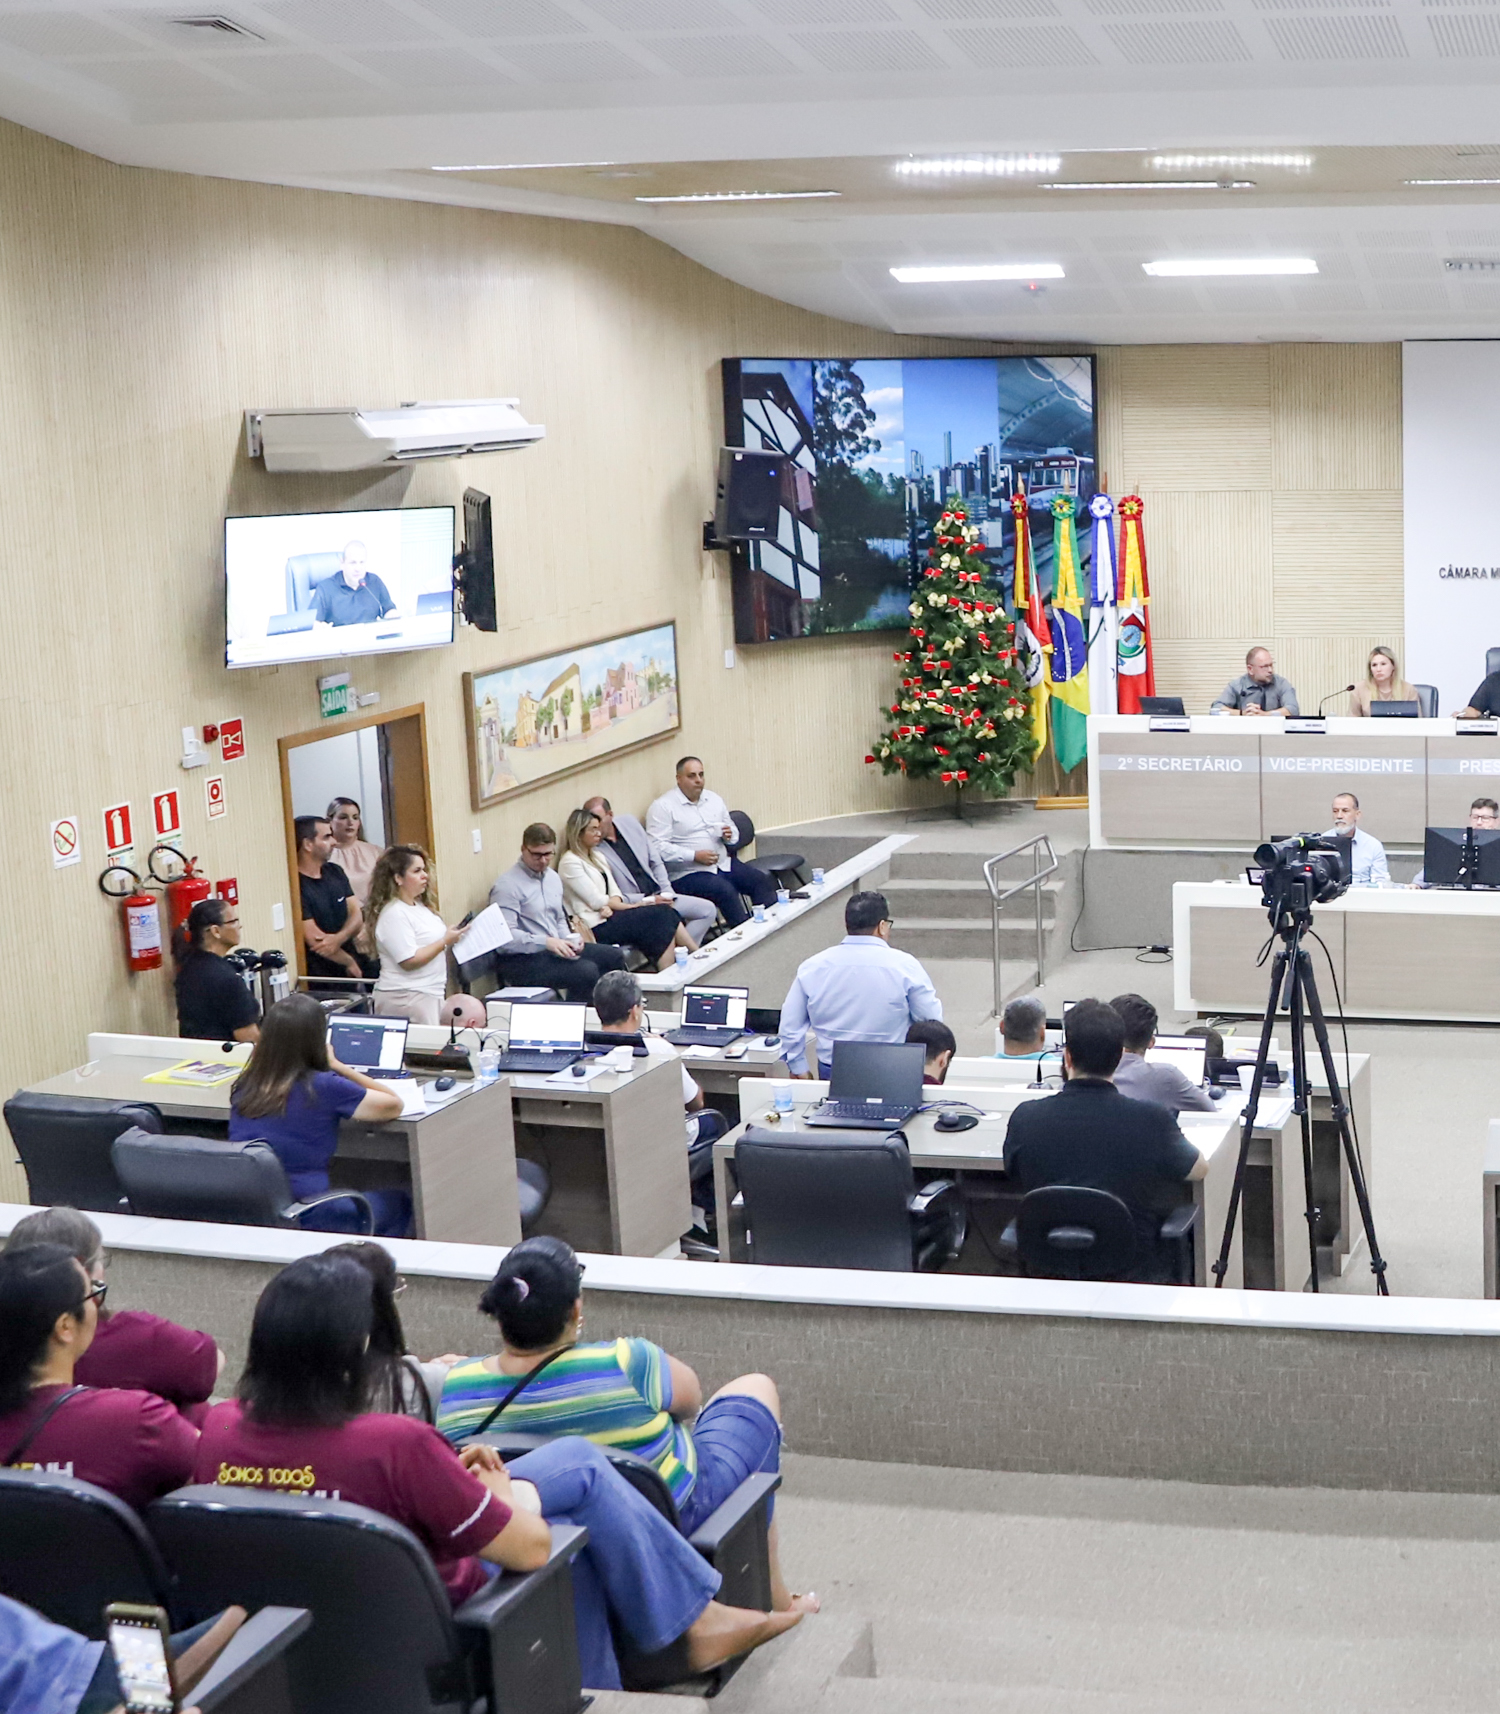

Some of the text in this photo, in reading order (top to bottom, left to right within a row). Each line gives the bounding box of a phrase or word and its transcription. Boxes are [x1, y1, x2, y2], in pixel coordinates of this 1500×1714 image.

[1439, 563, 1488, 580] CÂMARA
[322, 687, 346, 712] SAÍDA
[1137, 754, 1242, 772] SECRETÁRIO
[1269, 756, 1414, 774] VICE-PRESIDENTE
